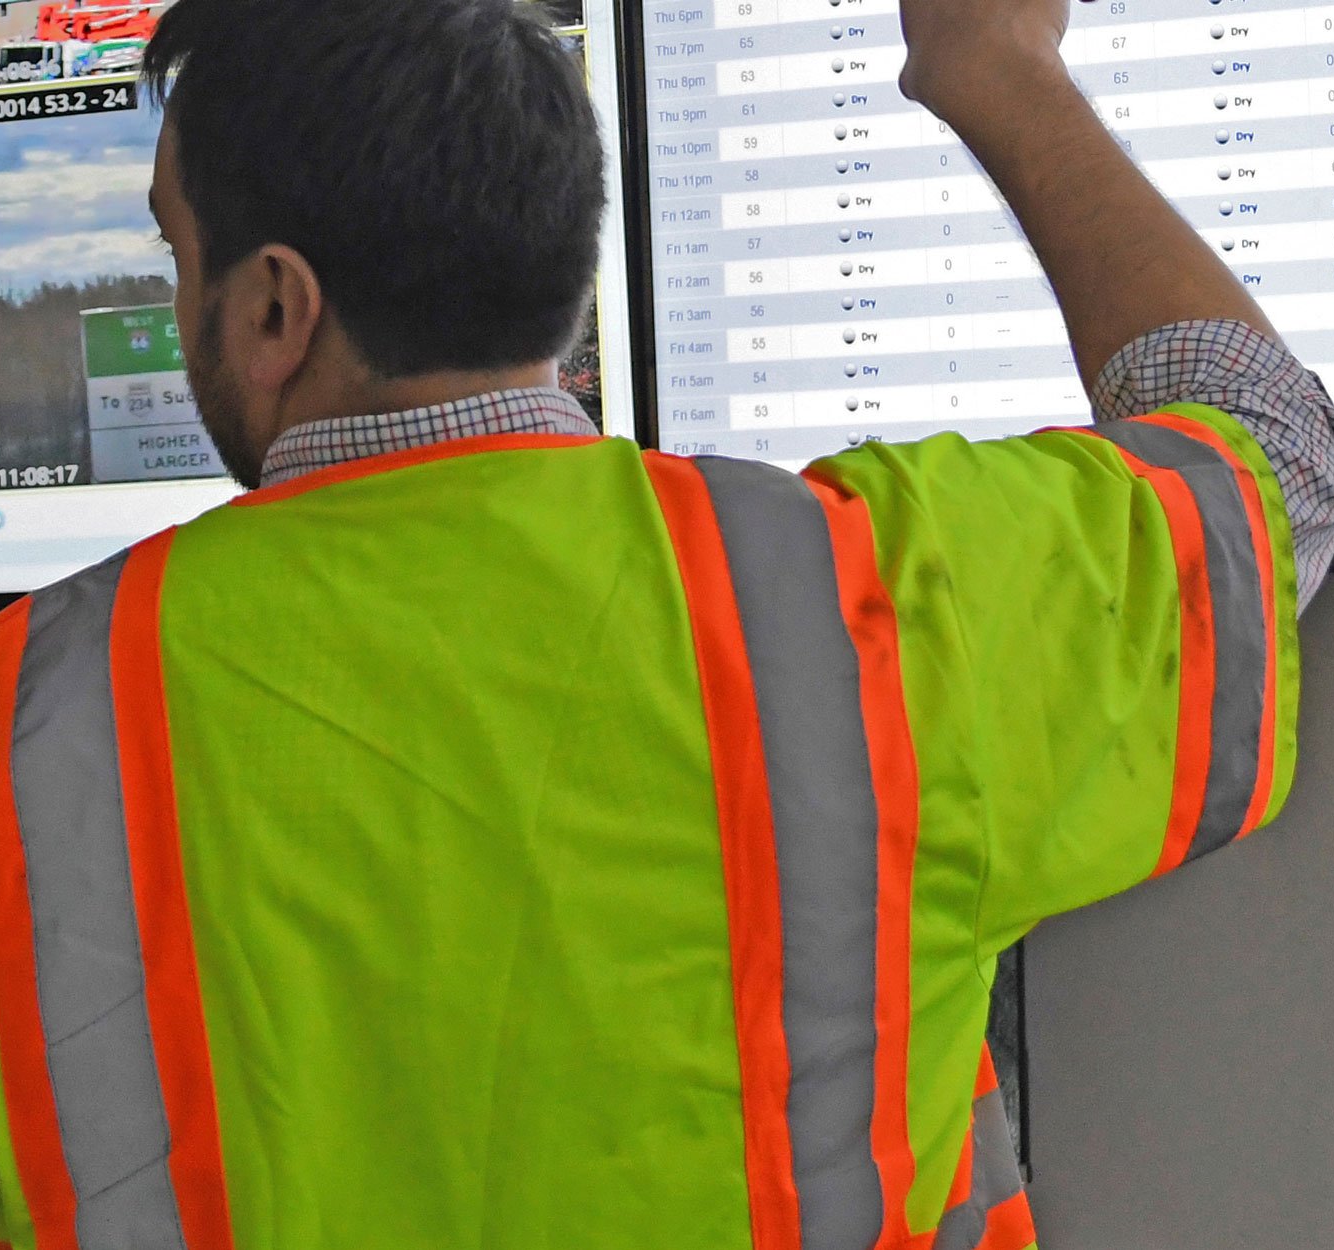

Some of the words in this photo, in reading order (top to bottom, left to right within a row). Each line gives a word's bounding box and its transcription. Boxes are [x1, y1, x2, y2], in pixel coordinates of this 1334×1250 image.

[738, 4, 752, 15] 69
[654, 12, 675, 24] Thu
[678, 10, 703, 24] 6pm
[849, 28, 864, 37] Dry
[1231, 28, 1248, 36] Dry
[655, 45, 676, 56] Thu
[680, 43, 704, 56] 7pm
[850, 62, 866, 70] Dry
[1233, 63, 1250, 72] Dry
[741, 70, 755, 82] 63
[656, 78, 678, 90] Thu
[681, 76, 705, 90] 8pm
[44, 91, 88, 113] 53.2
[102, 88, 128, 107] 24
[851, 95, 867, 105] Dry
[1235, 97, 1252, 107] Dry
[658, 110, 679, 123] Thu
[682, 109, 706, 123] 9pm
[853, 128, 868, 138] Dry
[656, 144, 677, 156] Thu
[681, 142, 711, 156] 10pm
[744, 137, 757, 149] 59
[854, 162, 870, 172] Dry
[657, 177, 678, 188] Thu
[683, 174, 712, 188] 11pm
[745, 169, 759, 182] 58
[856, 197, 871, 206] Dry
[680, 209, 710, 221] 12am
[857, 231, 873, 239] Dry
[685, 243, 708, 254] 1am
[748, 238, 761, 249] 57
[859, 265, 874, 274] Dry
[686, 276, 710, 288] 2am
[860, 299, 876, 309] Dry
[687, 309, 711, 321] 3am
[752, 337, 766, 350] 55
[862, 333, 877, 342] Dry
[688, 342, 712, 353] 4am
[863, 366, 879, 376] Dry
[690, 375, 713, 387] 5am
[100, 396, 120, 409] To
[865, 401, 880, 410] Dry
[690, 409, 715, 421] 6am
[755, 405, 768, 417] 53
[138, 433, 201, 449] HIGHER
[756, 439, 768, 451] 51
[691, 442, 716, 453] 7am
[144, 452, 211, 470] LARGER
